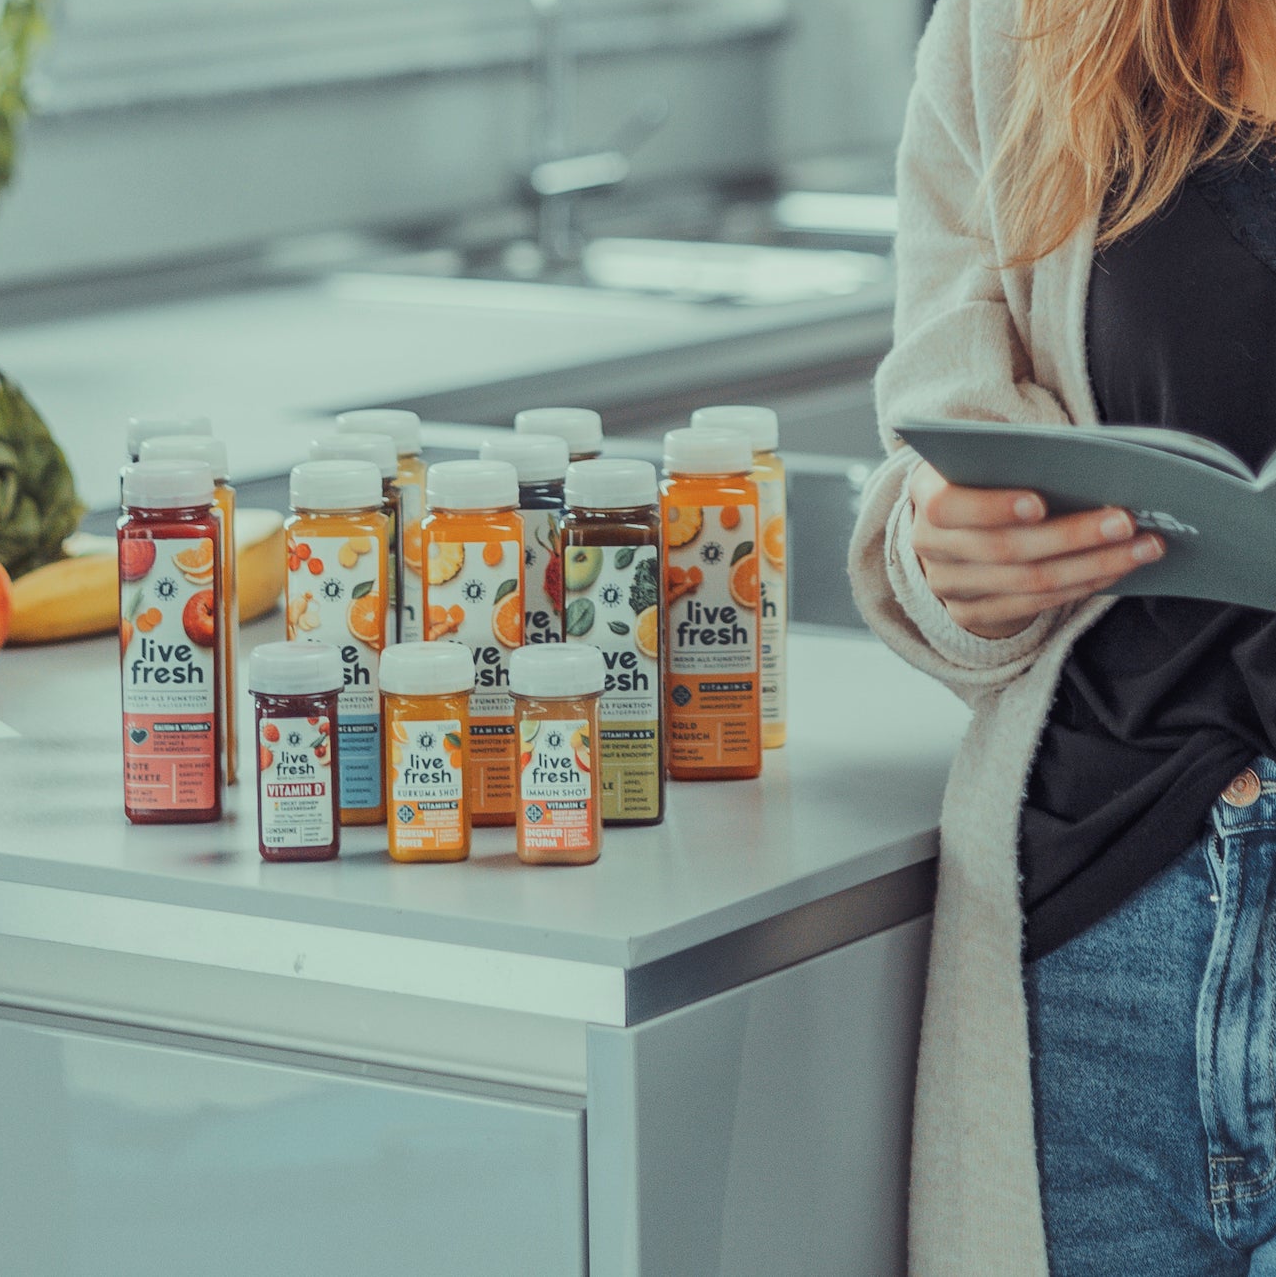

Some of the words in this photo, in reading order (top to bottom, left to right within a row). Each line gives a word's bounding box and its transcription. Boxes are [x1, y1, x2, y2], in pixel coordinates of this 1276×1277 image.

[687, 600, 738, 625] live
[677, 620, 748, 648] fresh
[141, 637, 193, 664] live
[602, 650, 639, 671] ve
[131, 659, 204, 686] fresh
[603, 668, 649, 692] esh
[672, 732, 710, 741] RAUSCH
[280, 750, 309, 765] live
[410, 753, 444, 770] live
[538, 752, 572, 769] live
[276, 762, 315, 778] fresh
[404, 768, 452, 786] fresh
[532, 767, 580, 785] fresh
[268, 784, 312, 797] VITAMIN
[398, 790, 436, 798] KURKUMA
[439, 788, 459, 797] SHOT
[525, 789, 559, 797] IMMUN
[562, 788, 586, 797] SHOT
[546, 801, 578, 810] VITAMIN
